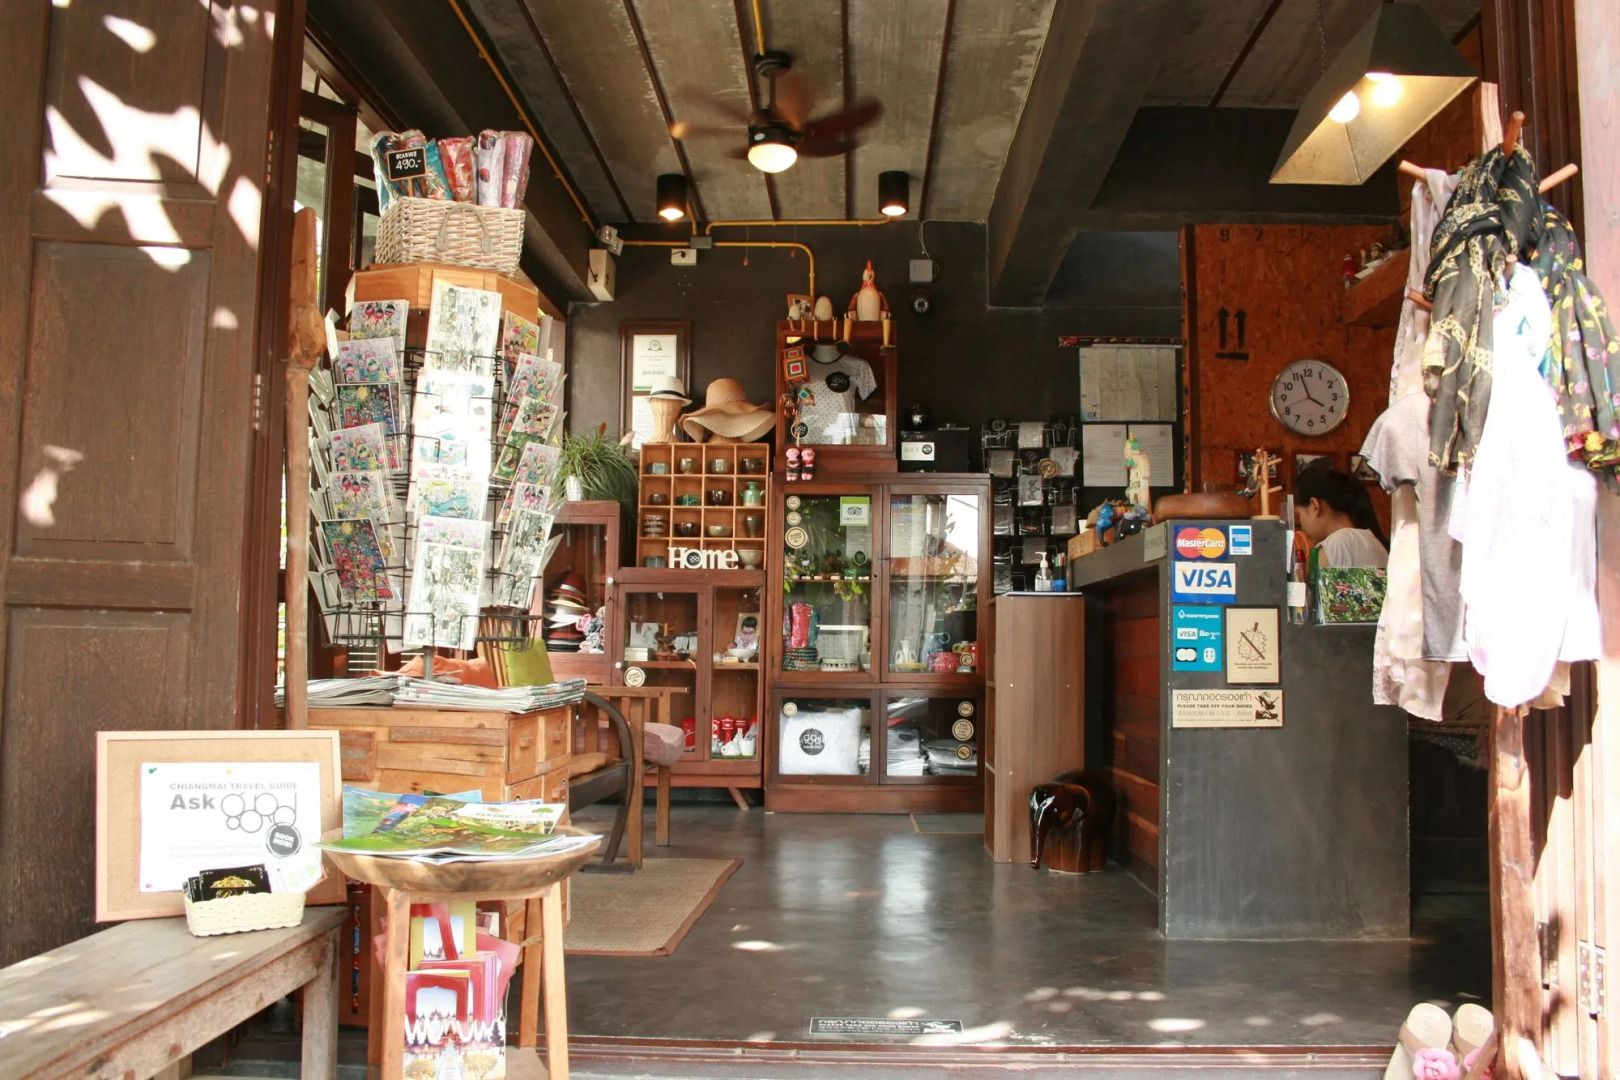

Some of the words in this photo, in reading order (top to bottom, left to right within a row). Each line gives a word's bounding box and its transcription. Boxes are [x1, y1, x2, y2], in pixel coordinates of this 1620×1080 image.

[1292, 373, 1299, 381] 11
[1303, 368, 1313, 377] 12
[1318, 371, 1322, 380] 1
[1283, 382, 1293, 391] 10
[1327, 380, 1333, 389] 2
[1280, 394, 1287, 402] 9
[1332, 392, 1338, 401] 3
[1285, 407, 1291, 415] 8
[1328, 406, 1334, 414] 4
[1294, 414, 1301, 423] 7
[1307, 419, 1314, 427] 6
[1320, 415, 1326, 423] 5
[1177, 538, 1224, 548] MasterCard
[667, 547, 739, 569] Home
[1180, 569, 1232, 588] VISA
[170, 794, 215, 810] Ask
